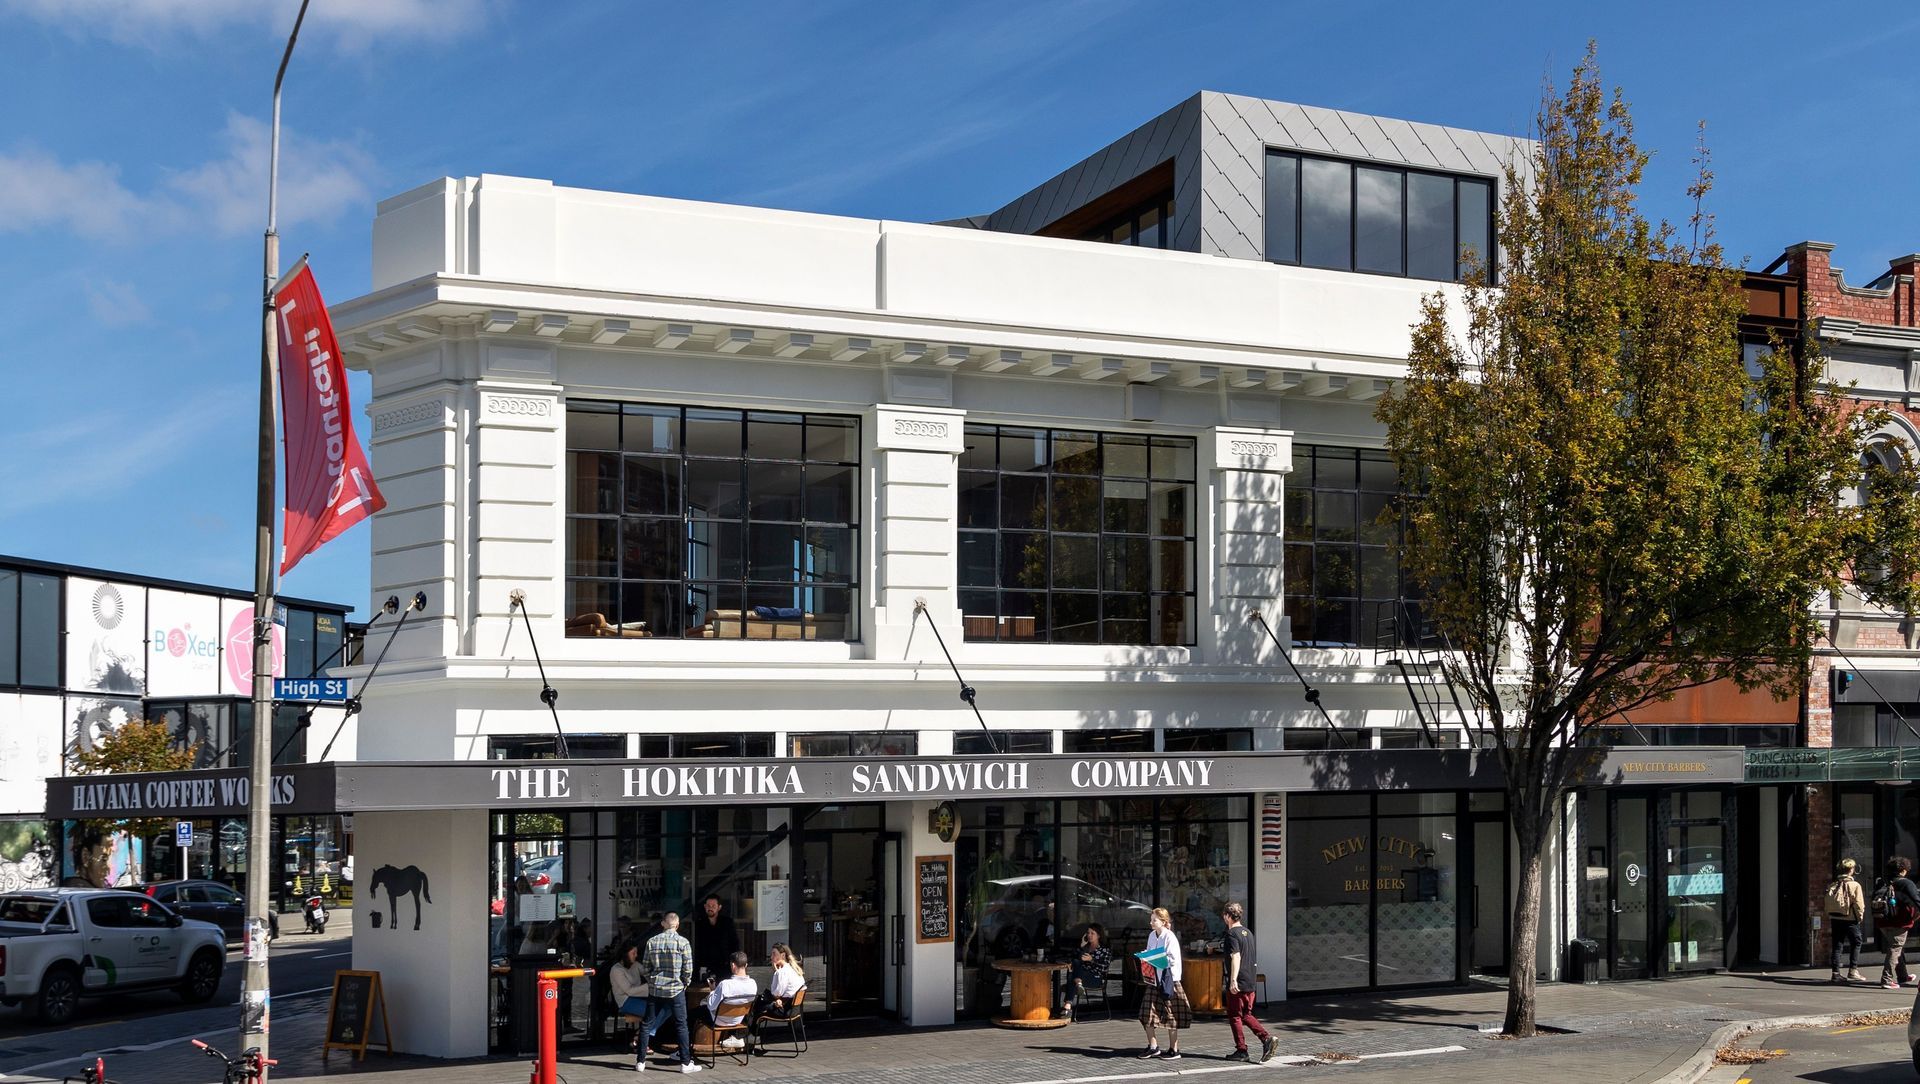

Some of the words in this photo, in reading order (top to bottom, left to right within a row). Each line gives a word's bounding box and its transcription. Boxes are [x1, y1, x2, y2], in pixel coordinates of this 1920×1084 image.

[281, 680, 319, 699] High
[325, 680, 343, 695] St
[1749, 752, 1801, 764] DUNCANS
[1623, 762, 1643, 772] NEW
[1645, 762, 1667, 772] CITY
[1668, 762, 1707, 772] BARBERS
[491, 768, 571, 800] THE
[621, 765, 806, 798] HOKITIKA
[852, 762, 1030, 794] SANDWICH
[1070, 760, 1215, 788] COMPANY
[73, 782, 142, 811] HAVANA
[145, 779, 216, 808] COFFEE
[220, 775, 296, 807] WOKS
[1321, 836, 1368, 865] NEW
[1377, 836, 1421, 860] CITY
[922, 886, 943, 898] OPEN
[1344, 878, 1406, 892] BARBERS
